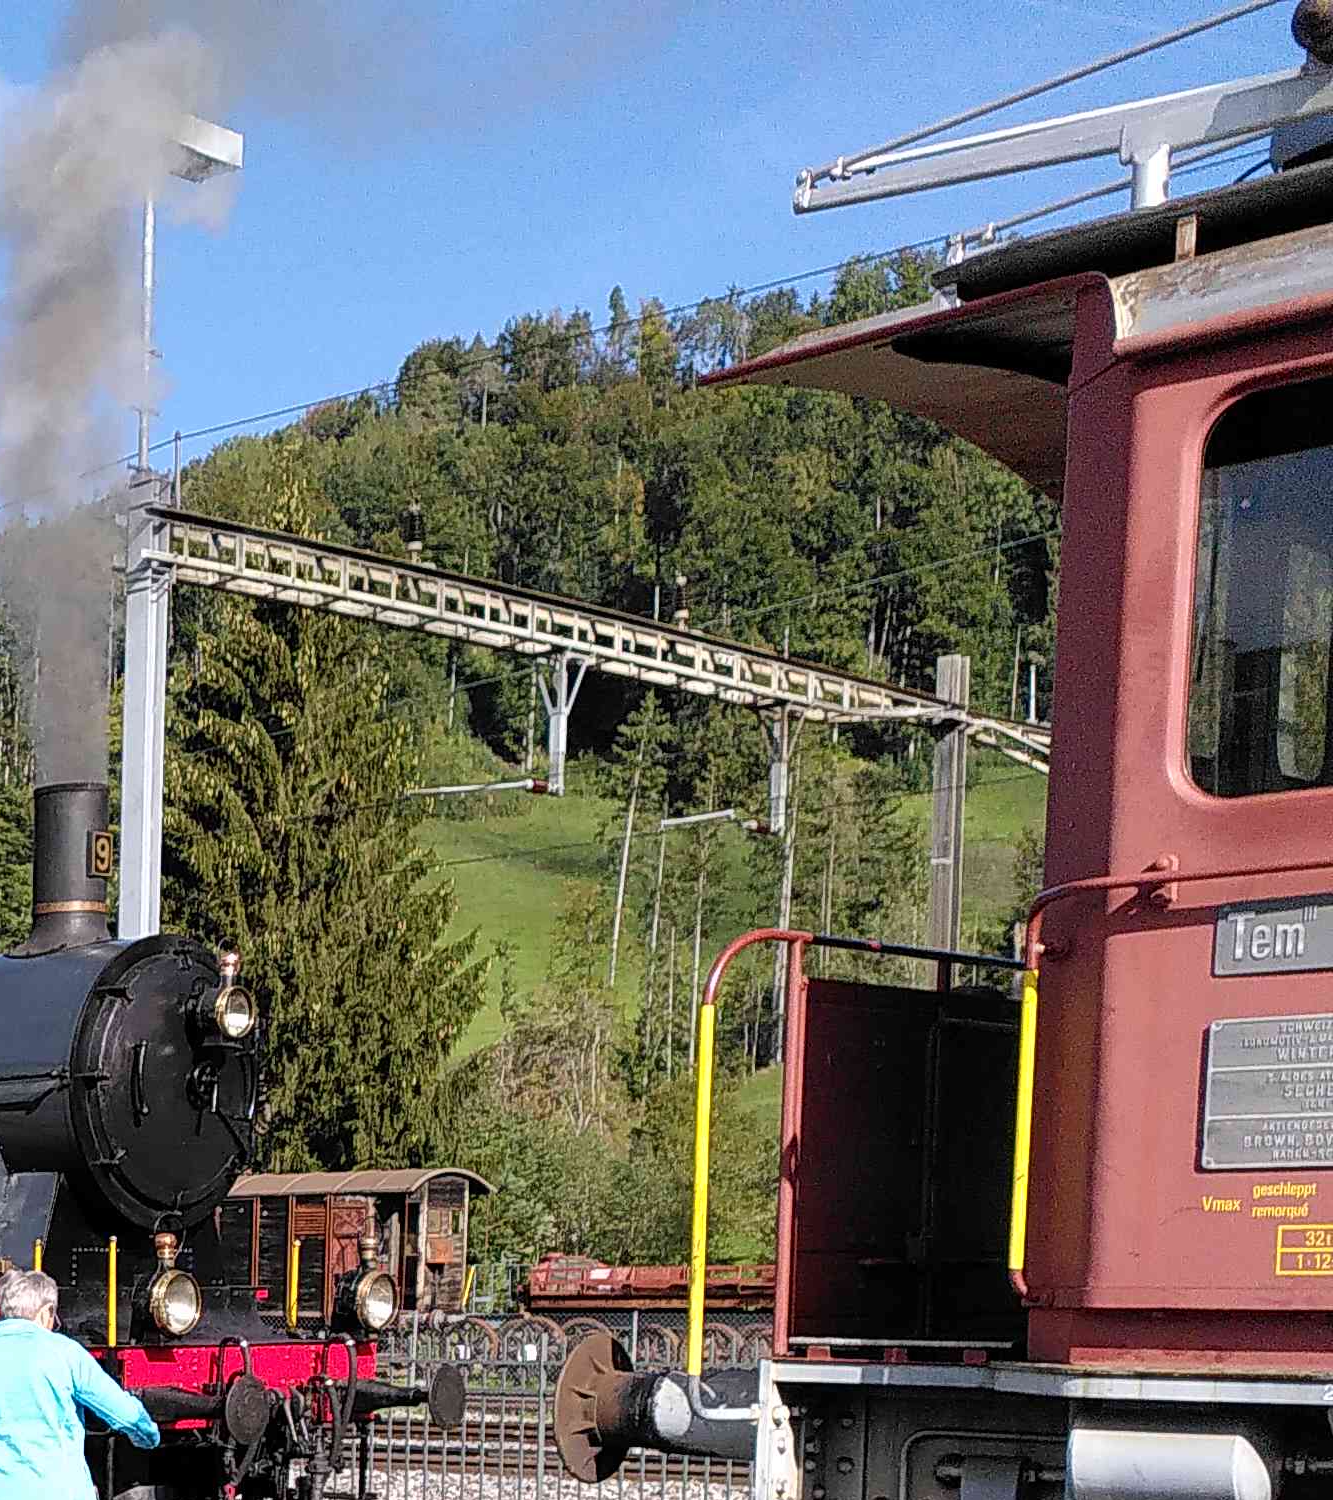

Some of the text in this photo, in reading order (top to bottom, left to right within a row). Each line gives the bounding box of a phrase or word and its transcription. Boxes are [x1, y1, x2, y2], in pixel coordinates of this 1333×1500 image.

[96, 837, 110, 871] 9
[1252, 1181, 1317, 1200] geschleppt
[1202, 1195, 1243, 1212] Vmax
